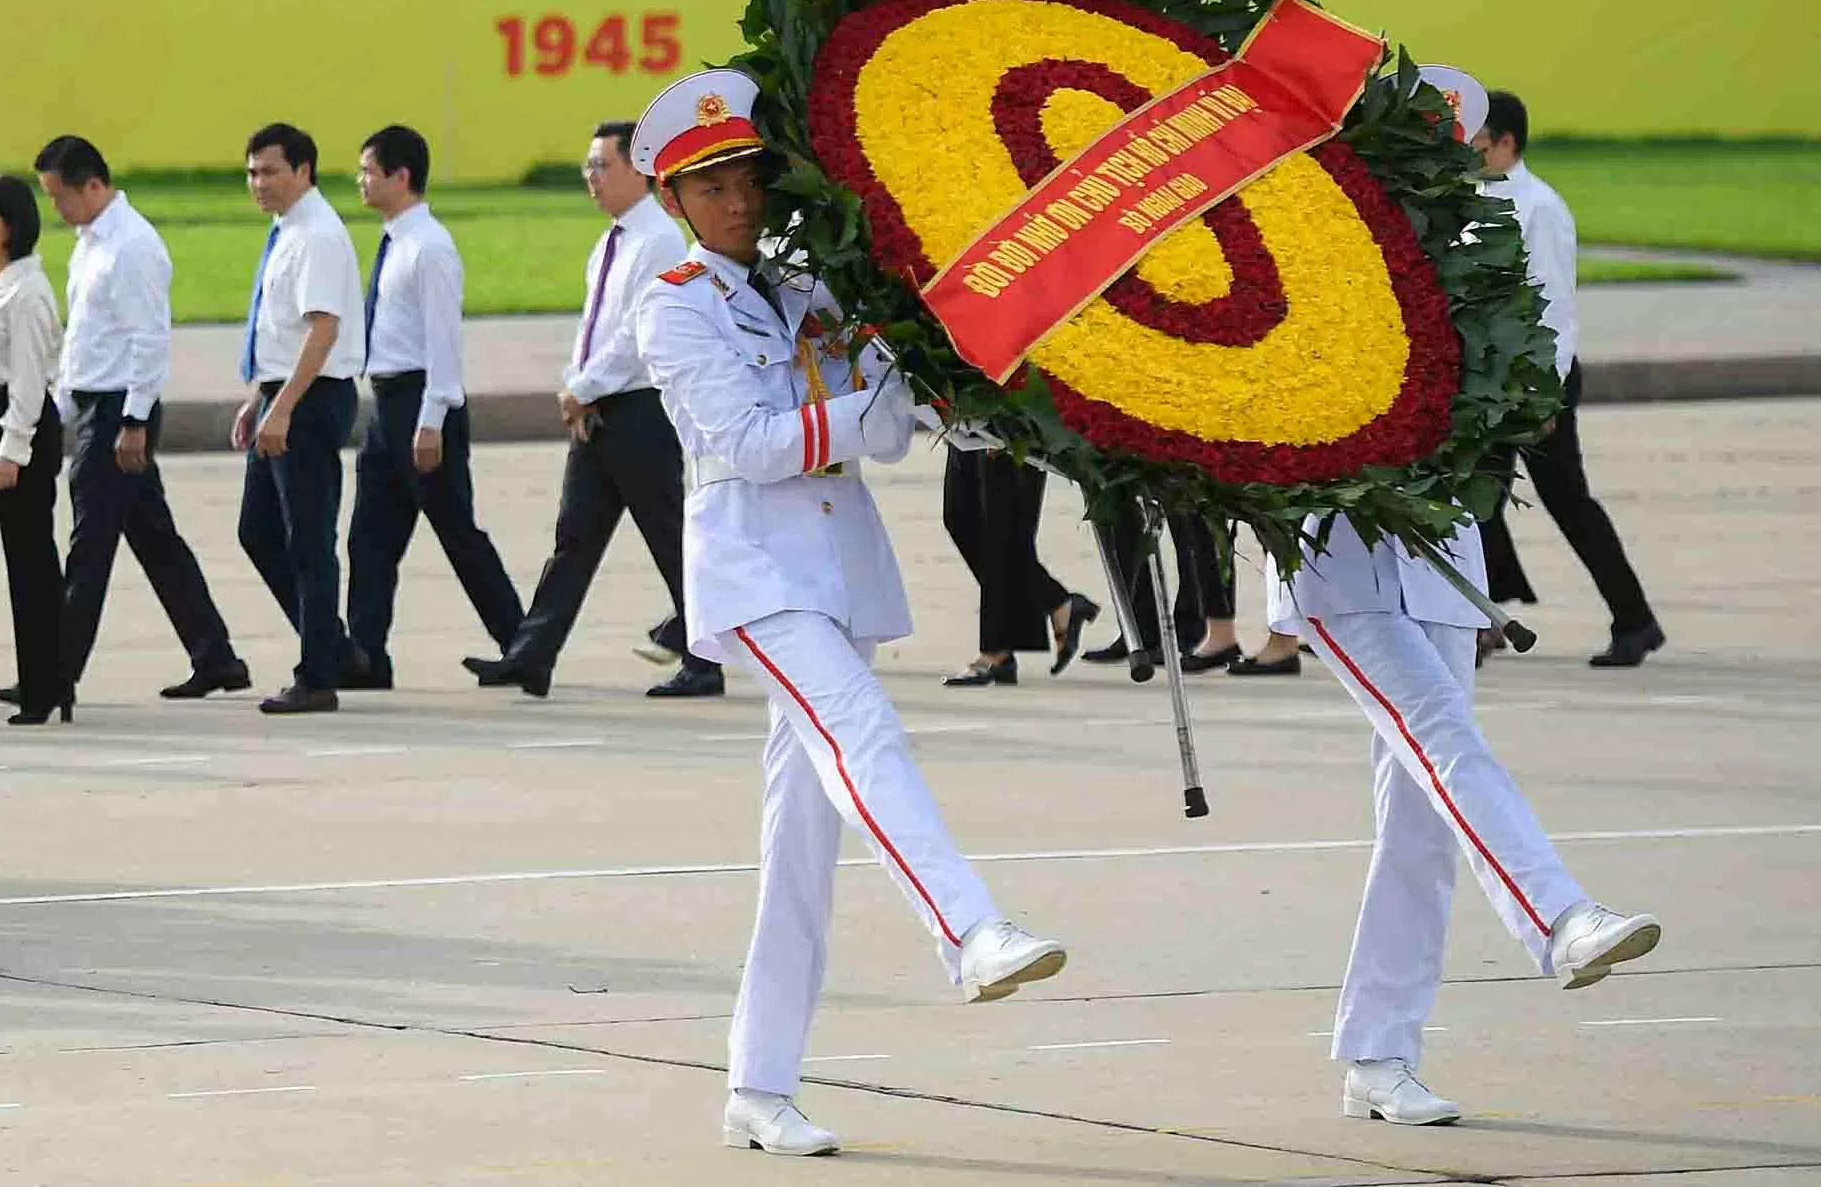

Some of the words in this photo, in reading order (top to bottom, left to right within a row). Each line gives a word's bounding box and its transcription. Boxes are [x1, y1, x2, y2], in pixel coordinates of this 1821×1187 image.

[495, 13, 682, 78] 1945
[1147, 118, 1194, 156] CHÍ
[1165, 103, 1226, 143] MINH
[1094, 149, 1154, 187] TỊCH
[1067, 169, 1121, 212] CHỦ
[1013, 212, 1069, 254] NHỚ
[1045, 198, 1094, 230] ƠN
[1117, 208, 1157, 234] BỘ
[987, 239, 1042, 274] ĐỜI
[963, 261, 1016, 298] ĐỜI
